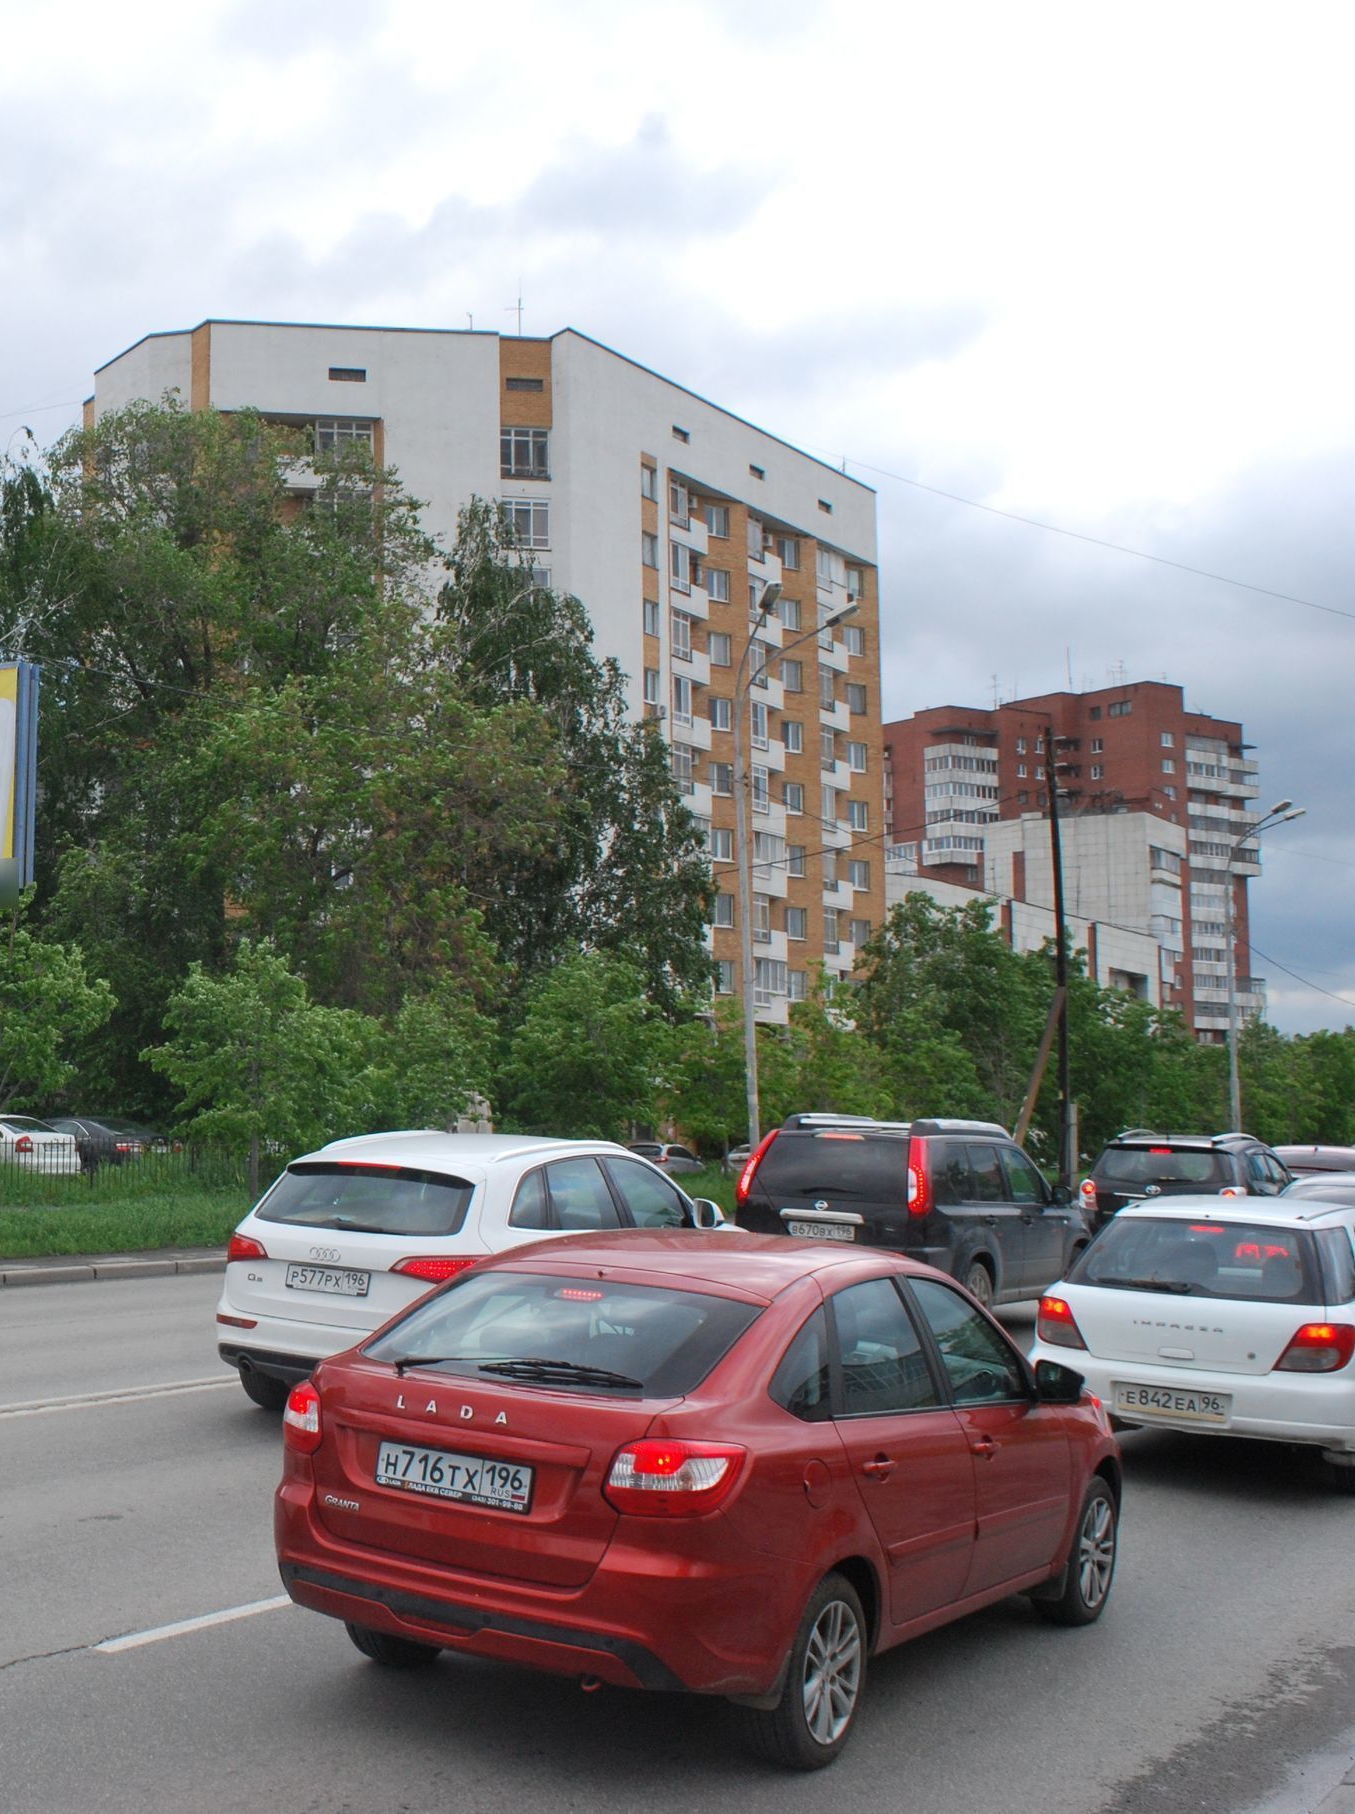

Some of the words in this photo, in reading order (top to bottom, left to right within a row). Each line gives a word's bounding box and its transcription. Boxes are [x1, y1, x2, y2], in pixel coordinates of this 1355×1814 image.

[345, 1272, 365, 1287] 196
[396, 1395, 509, 1425] LADA
[1201, 1396, 1220, 1411] 96
[485, 1464, 523, 1491] 196
[490, 1486, 511, 1499] RUS
[325, 1494, 360, 1512] GRANTA
